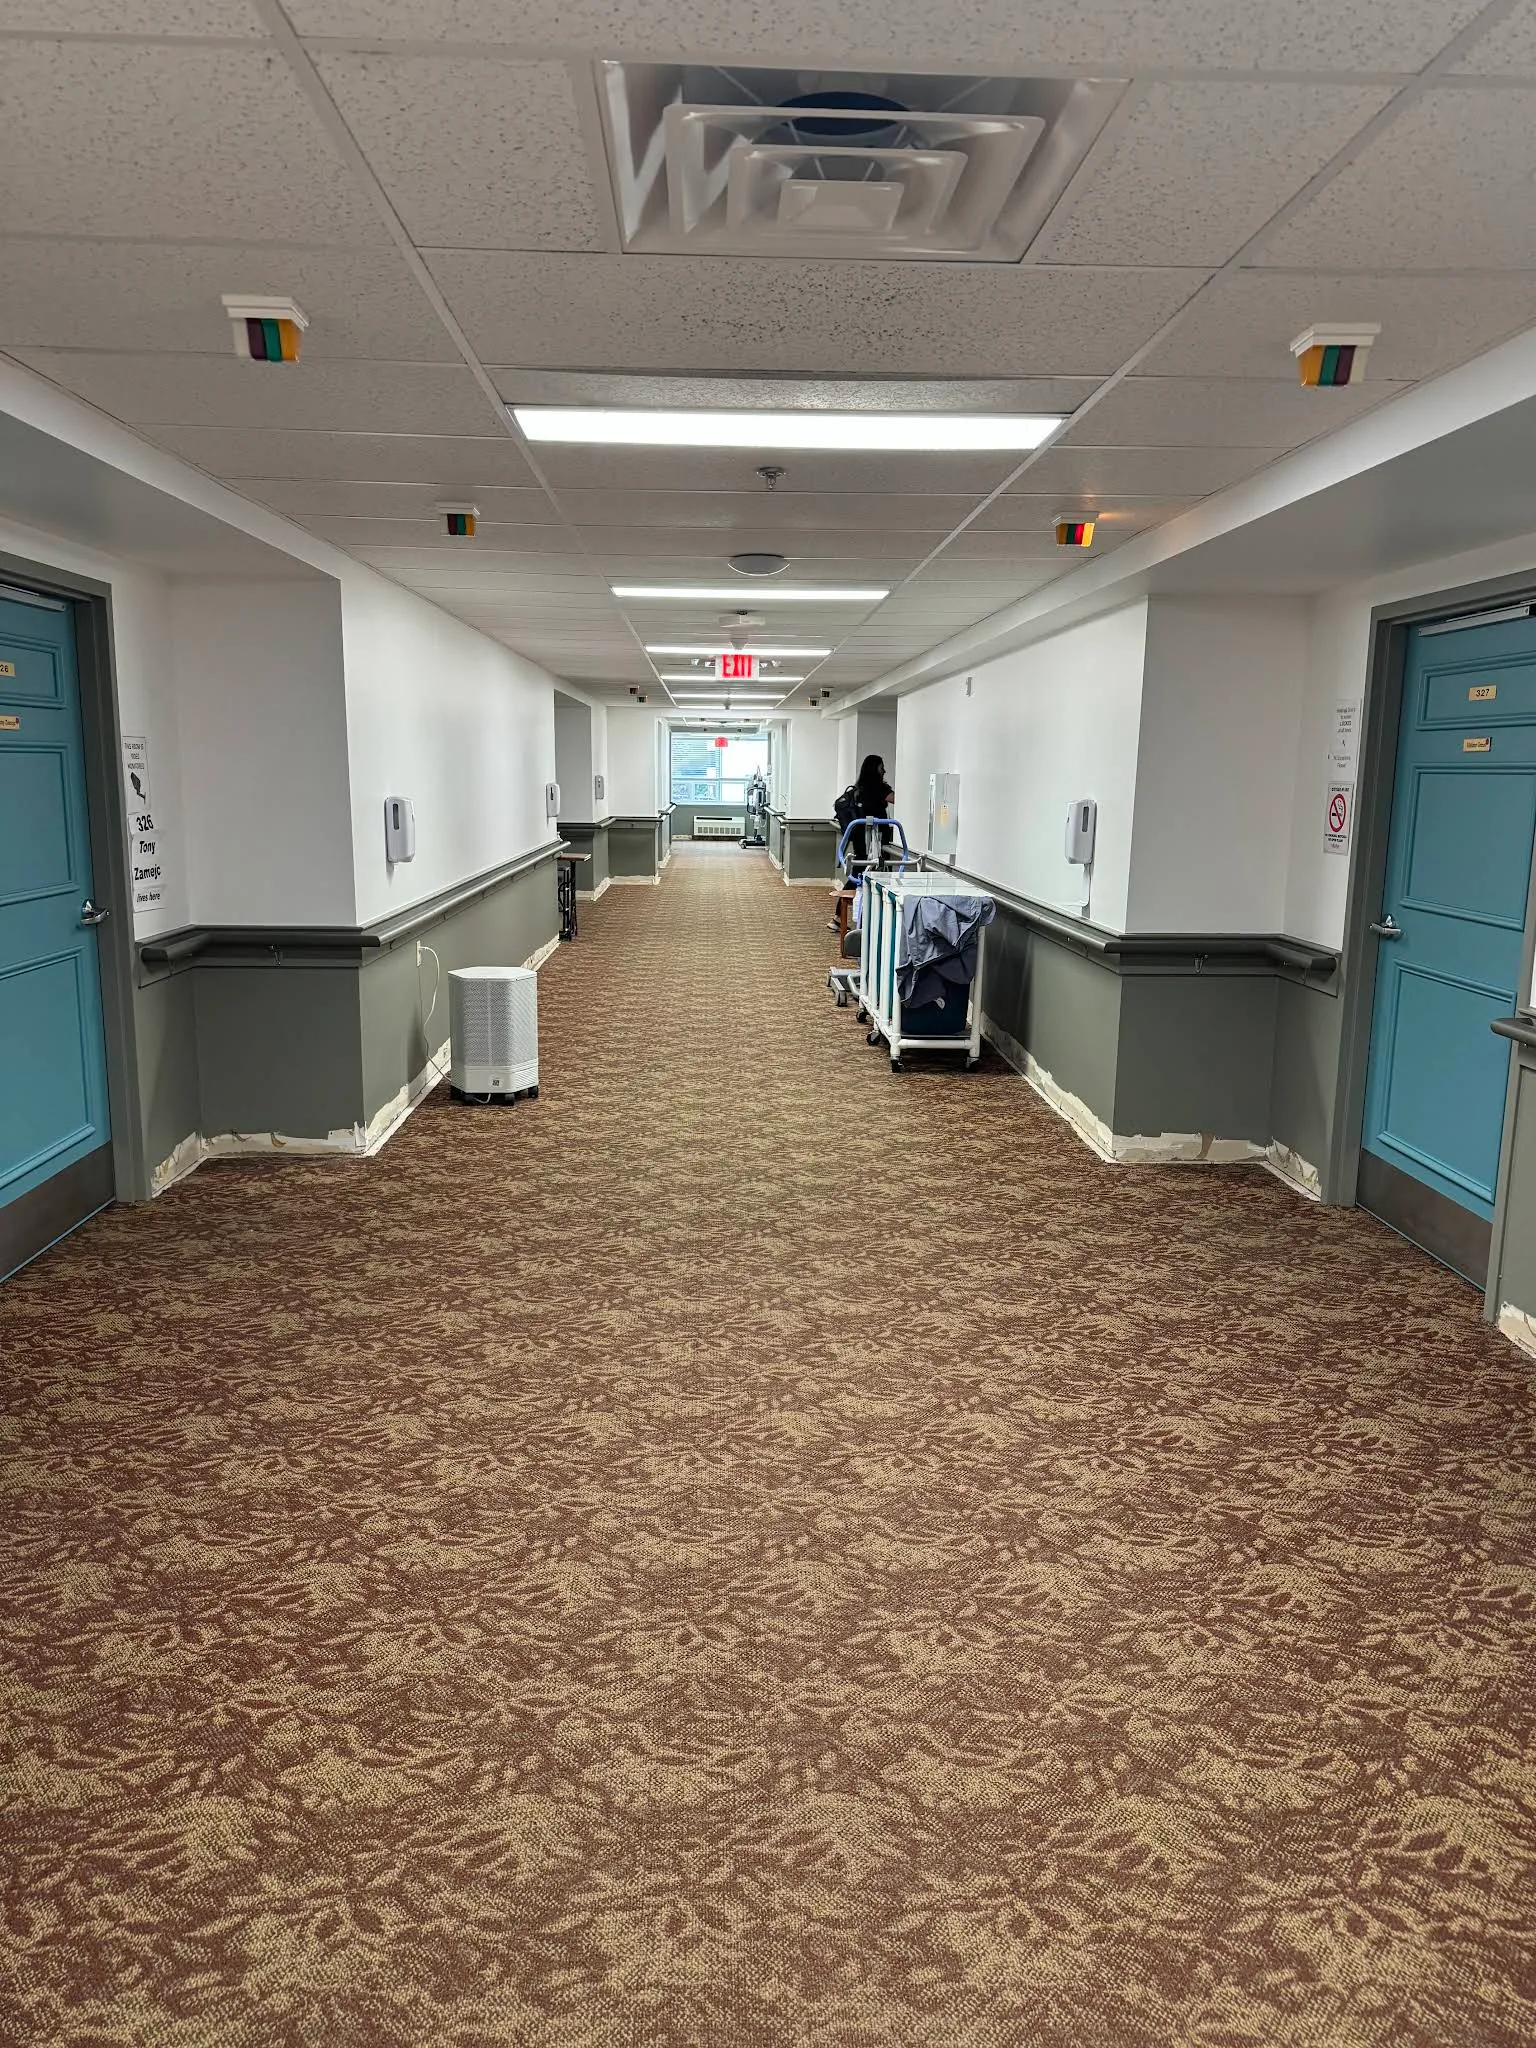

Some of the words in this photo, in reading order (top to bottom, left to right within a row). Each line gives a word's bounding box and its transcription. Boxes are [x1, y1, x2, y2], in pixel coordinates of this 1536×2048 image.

[721, 654, 753, 678] EXIT
[1475, 688, 1490, 697] 327
[136, 814, 154, 832] 326
[139, 840, 156, 855] Tony
[133, 863, 162, 881] Zamejc
[136, 893, 148, 903] lives
[149, 891, 161, 901] here
